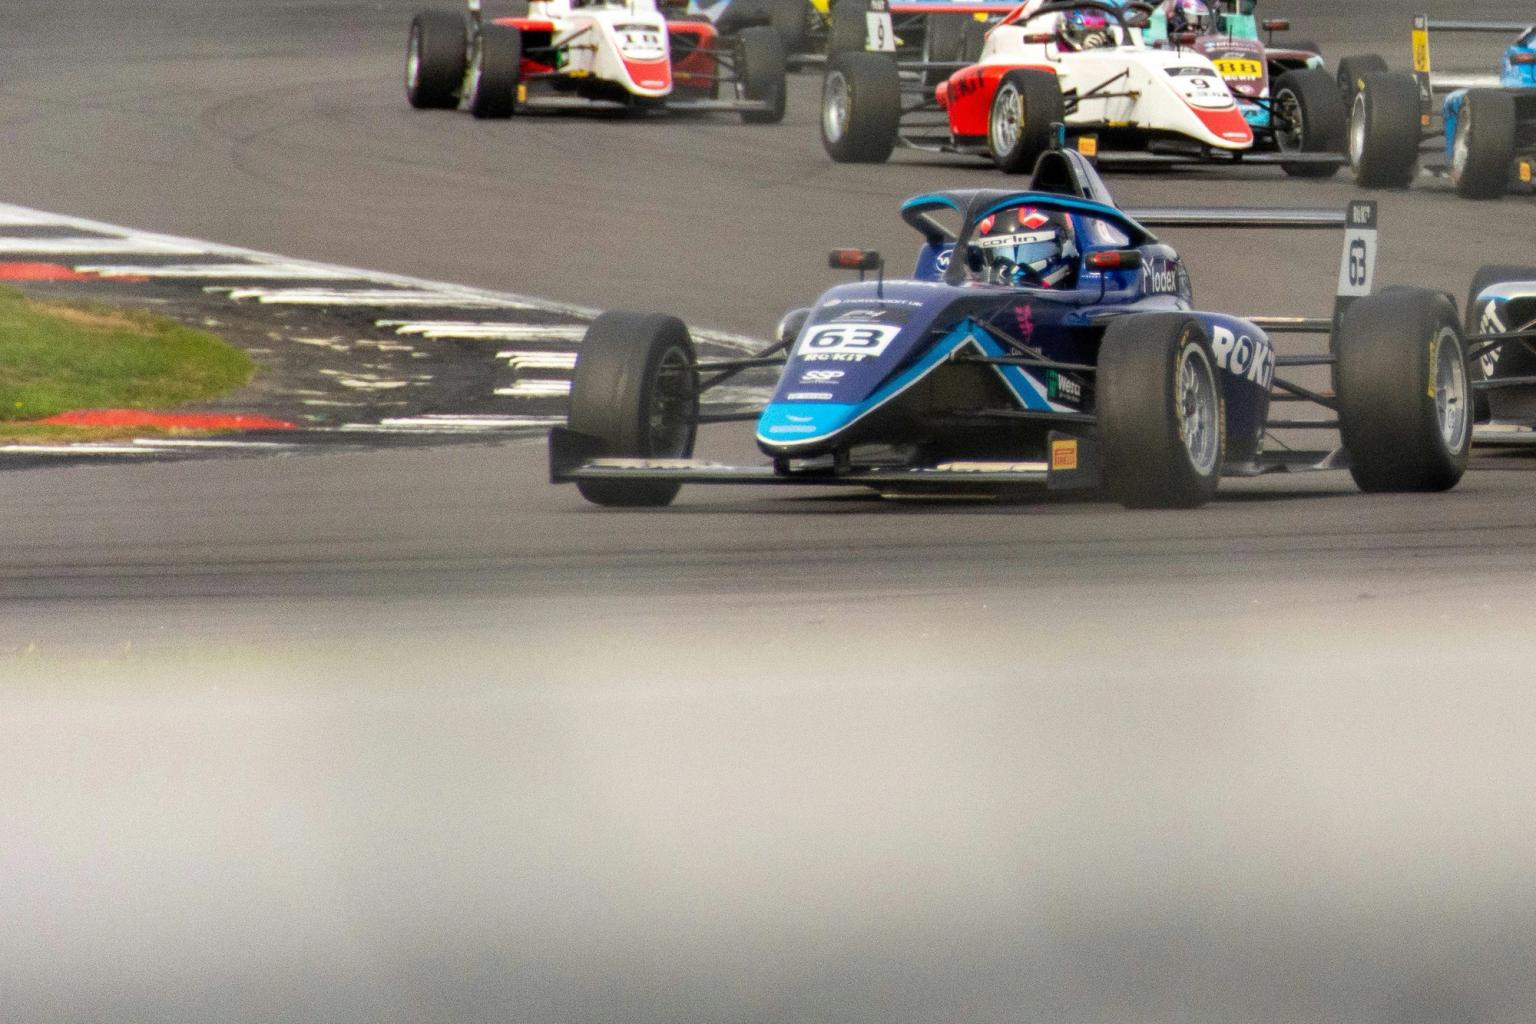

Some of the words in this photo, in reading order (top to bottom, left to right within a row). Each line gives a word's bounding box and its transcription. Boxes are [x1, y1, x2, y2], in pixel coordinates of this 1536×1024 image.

[1189, 78, 1211, 90] 9
[982, 234, 1038, 248] carlin
[1348, 239, 1367, 286] 63
[808, 328, 884, 349] 63
